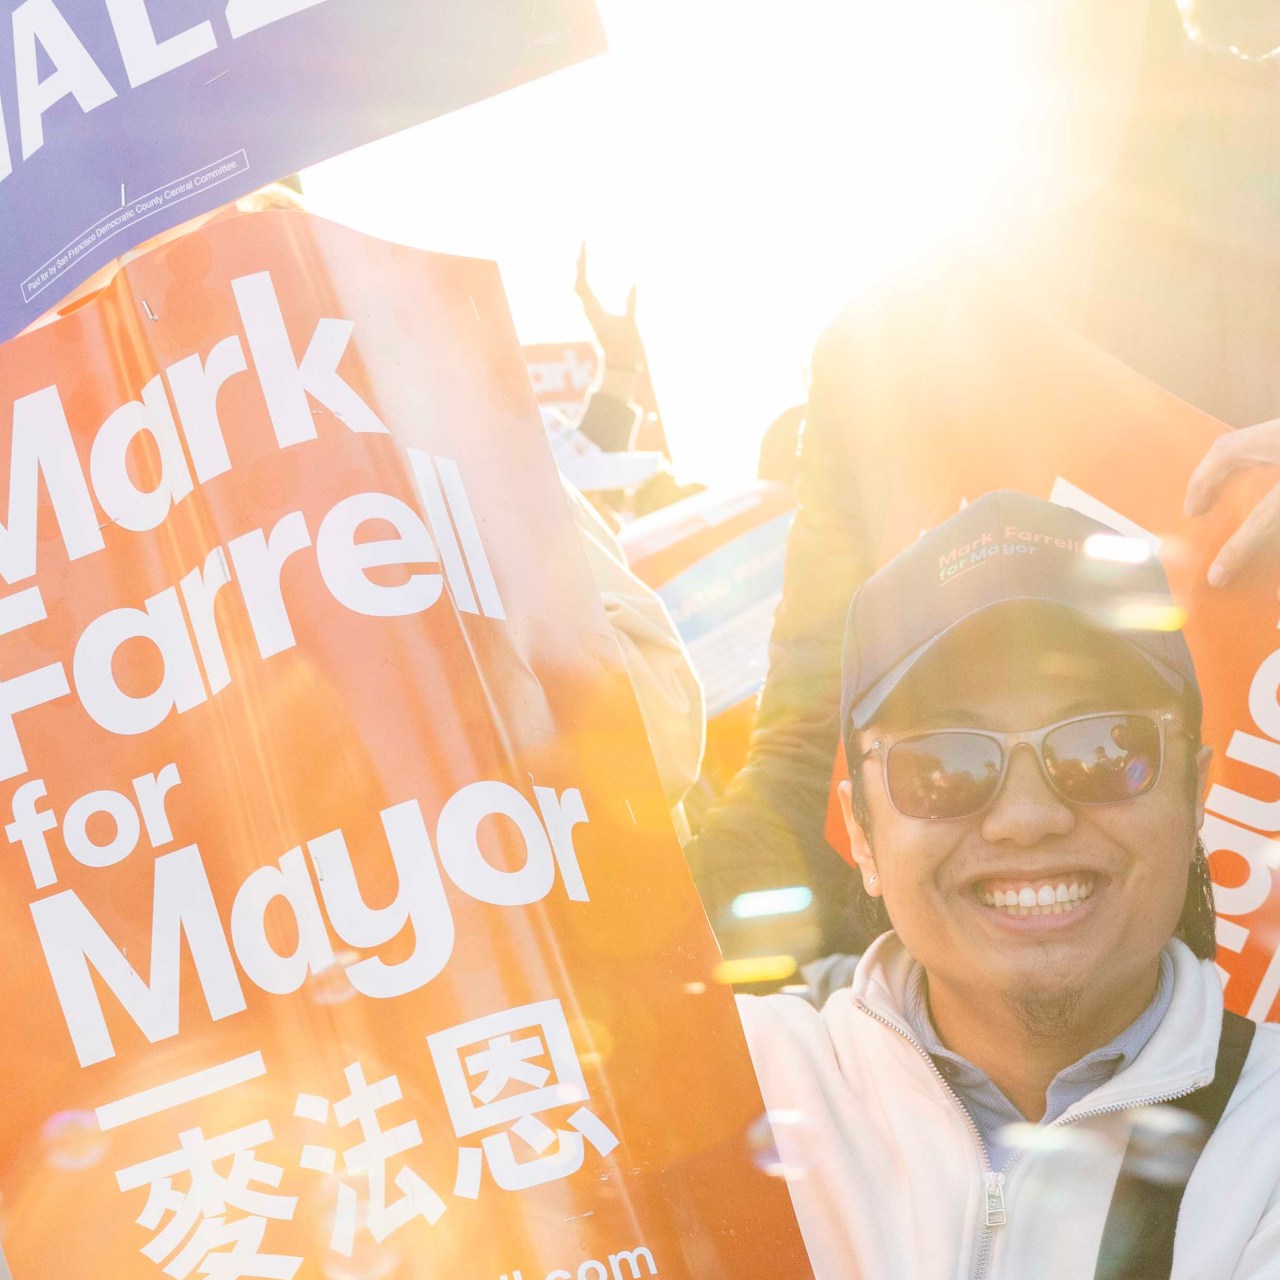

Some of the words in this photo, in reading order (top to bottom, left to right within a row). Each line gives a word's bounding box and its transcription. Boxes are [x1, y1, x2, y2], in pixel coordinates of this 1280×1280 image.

[27, 277, 41, 292] Paid
[39, 269, 49, 282] for
[48, 264, 57, 278] by
[56, 253, 69, 269] San
[68, 234, 96, 260] Francisco
[95, 208, 135, 238] Democratic
[135, 194, 163, 213] County
[164, 180, 193, 200] Central
[194, 159, 239, 186] Committee.
[528, 350, 595, 393] ark
[938, 531, 995, 568] Mark
[1005, 525, 1081, 554] Farrell
[938, 557, 968, 581] for
[970, 543, 1038, 564] Mayor
[5, 763, 181, 889] for
[29, 780, 590, 1068] Mayor
